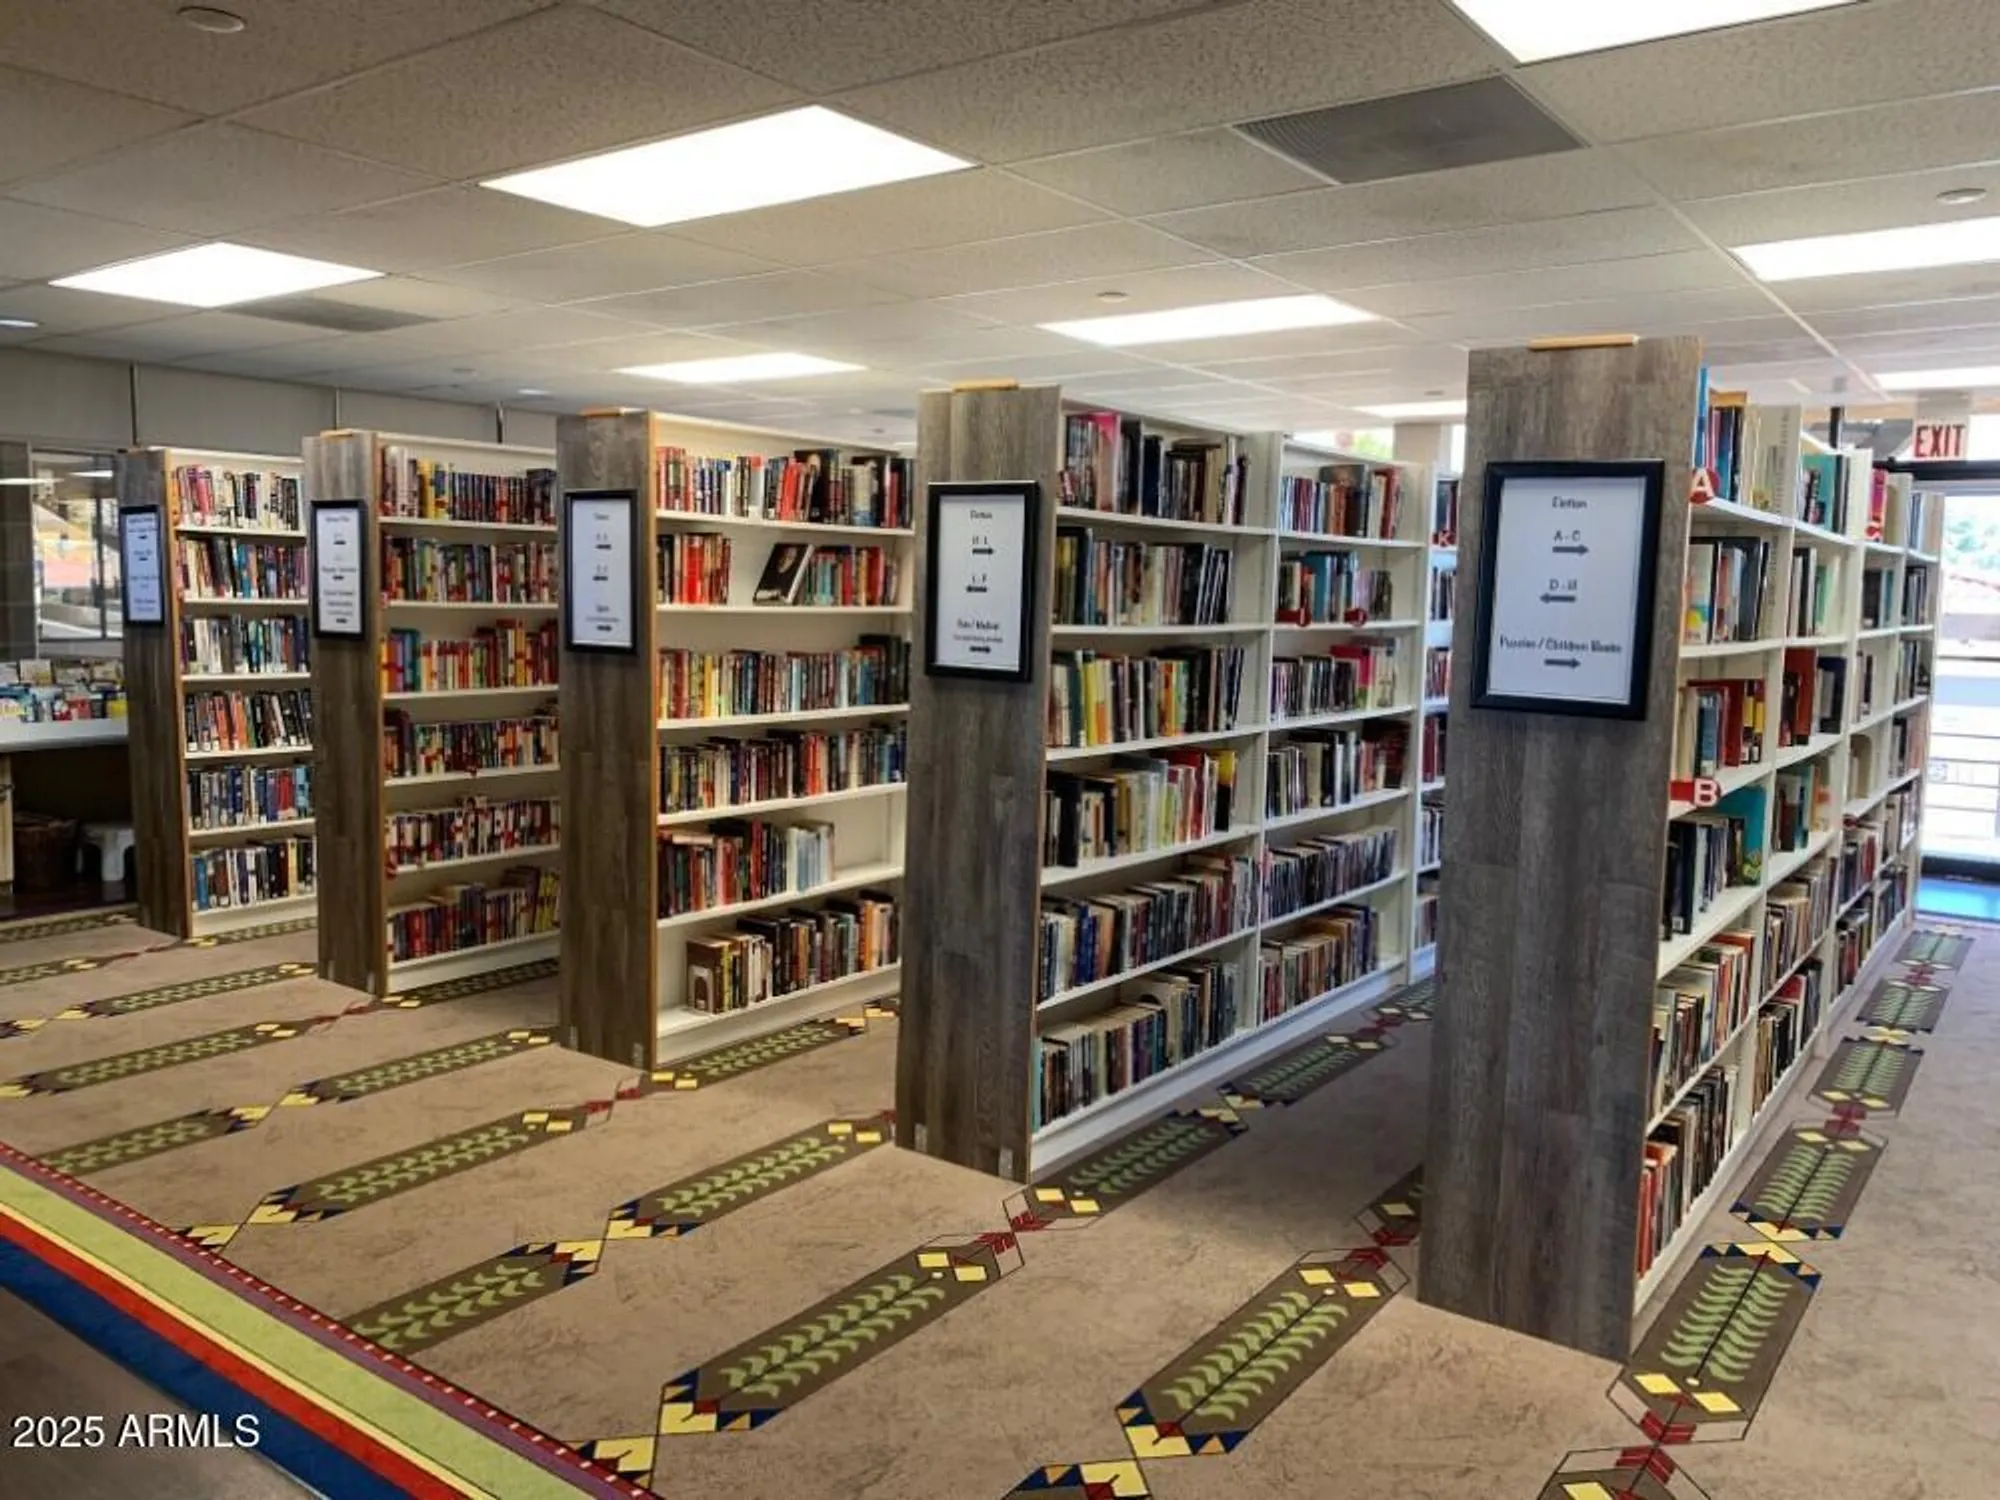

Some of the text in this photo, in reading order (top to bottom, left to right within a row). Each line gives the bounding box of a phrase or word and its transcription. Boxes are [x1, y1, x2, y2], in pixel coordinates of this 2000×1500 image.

[1915, 424, 1966, 457] EXIT
[1690, 468, 1714, 499] A
[1694, 778, 1718, 807] B
